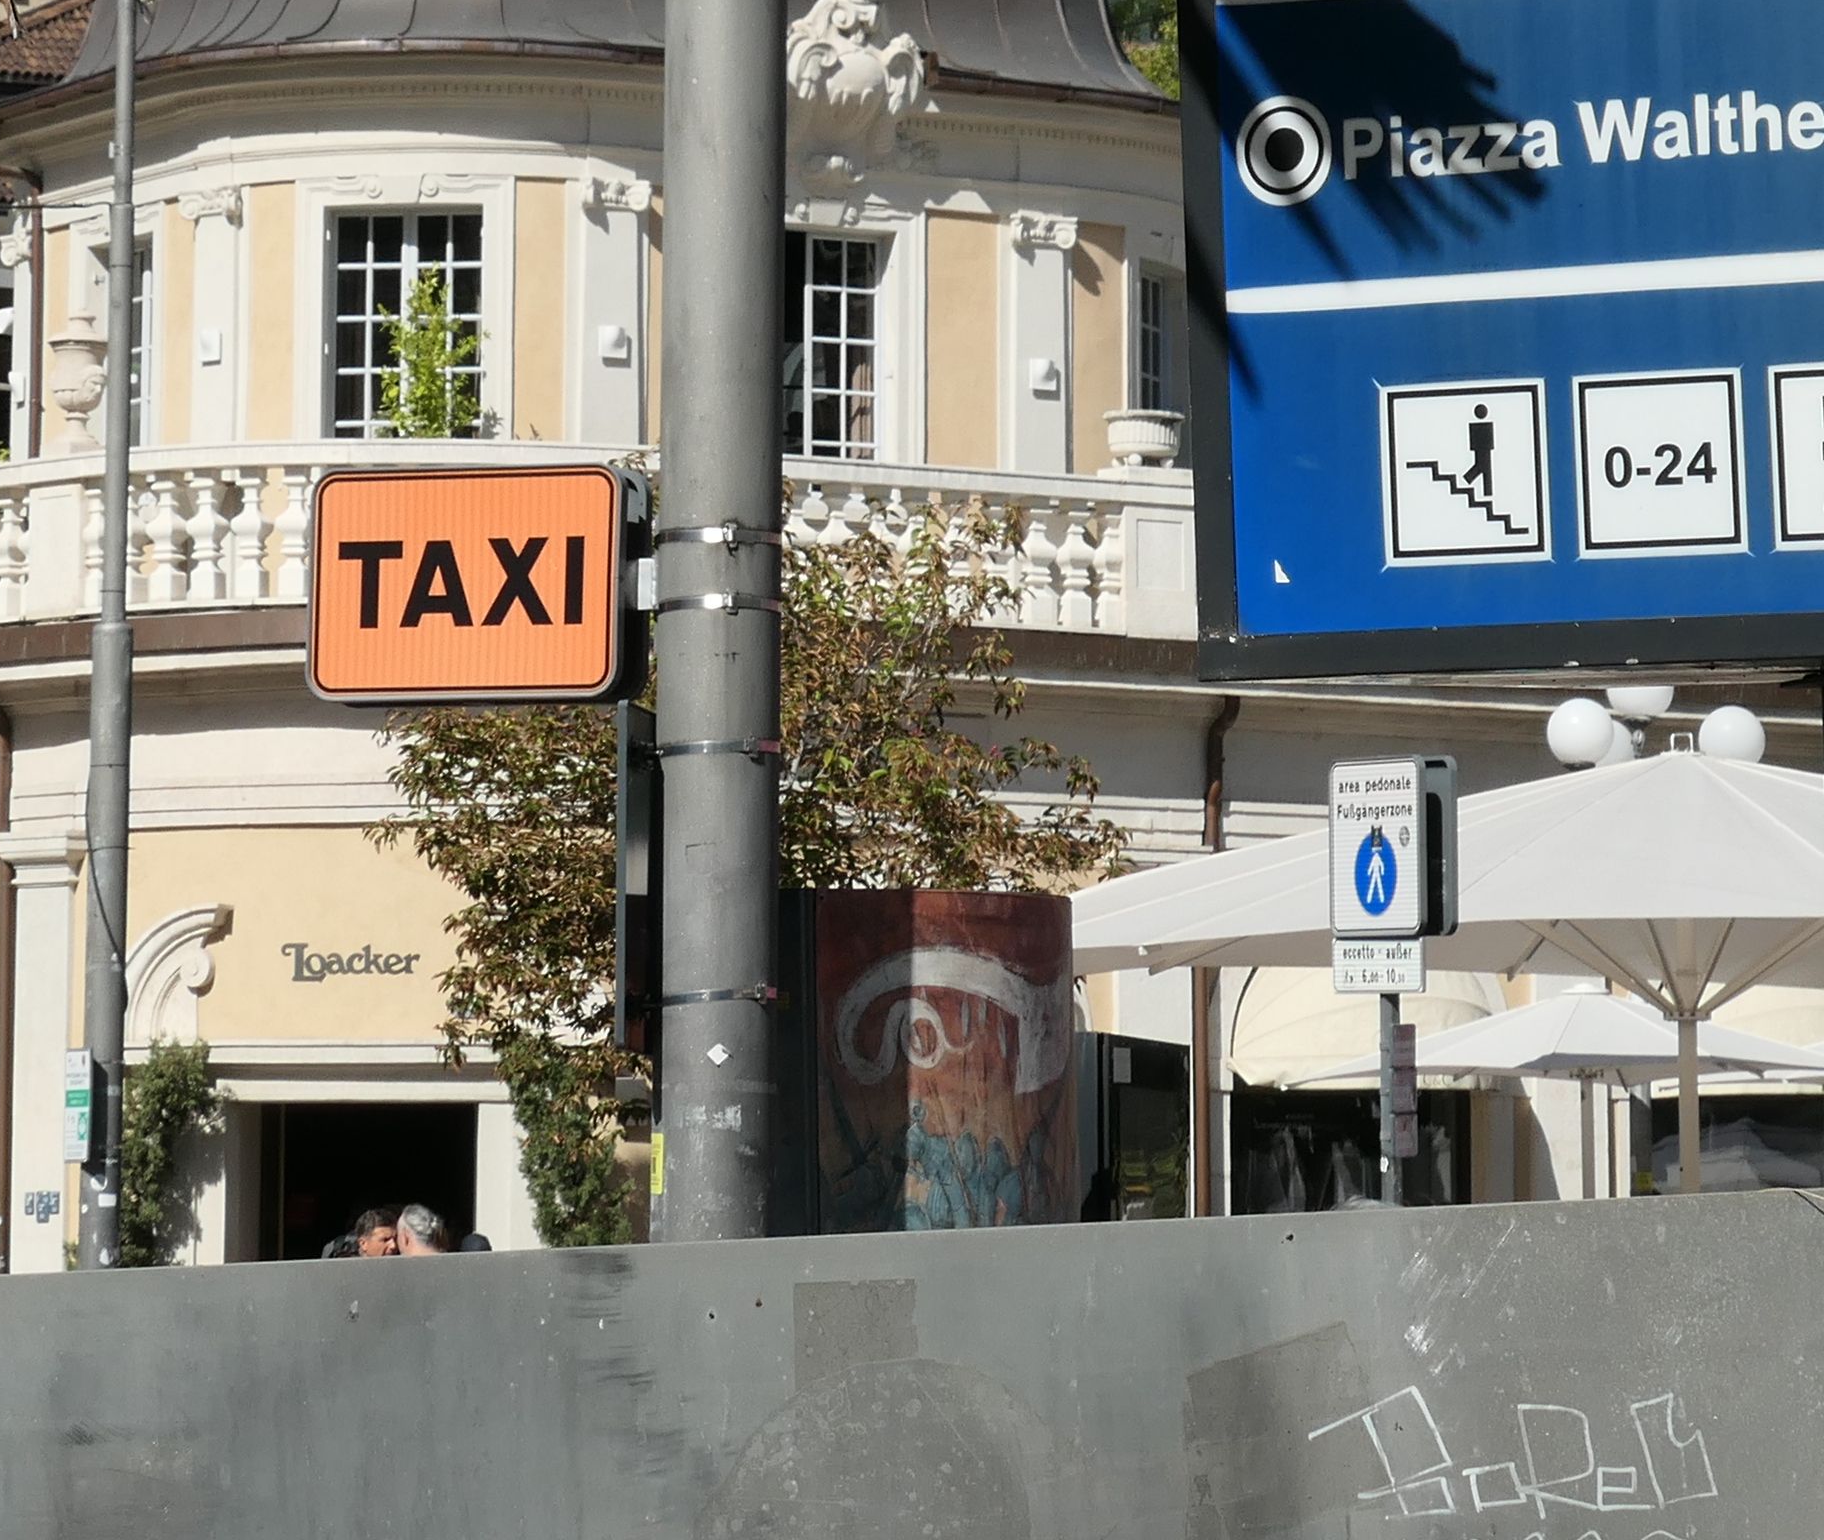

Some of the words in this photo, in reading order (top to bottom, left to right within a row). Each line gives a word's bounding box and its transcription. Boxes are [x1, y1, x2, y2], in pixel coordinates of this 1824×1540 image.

[1342, 114, 1558, 181] Piazza
[1604, 440, 1717, 489] 0-24
[338, 536, 585, 629] TAXI
[1338, 782, 1360, 793] area
[1365, 778, 1411, 792] pedonale
[1337, 803, 1413, 821] Fußgängerzone
[282, 941, 421, 982] Loacker
[1343, 945, 1375, 959] eccetto
[1386, 943, 1412, 959] außer
